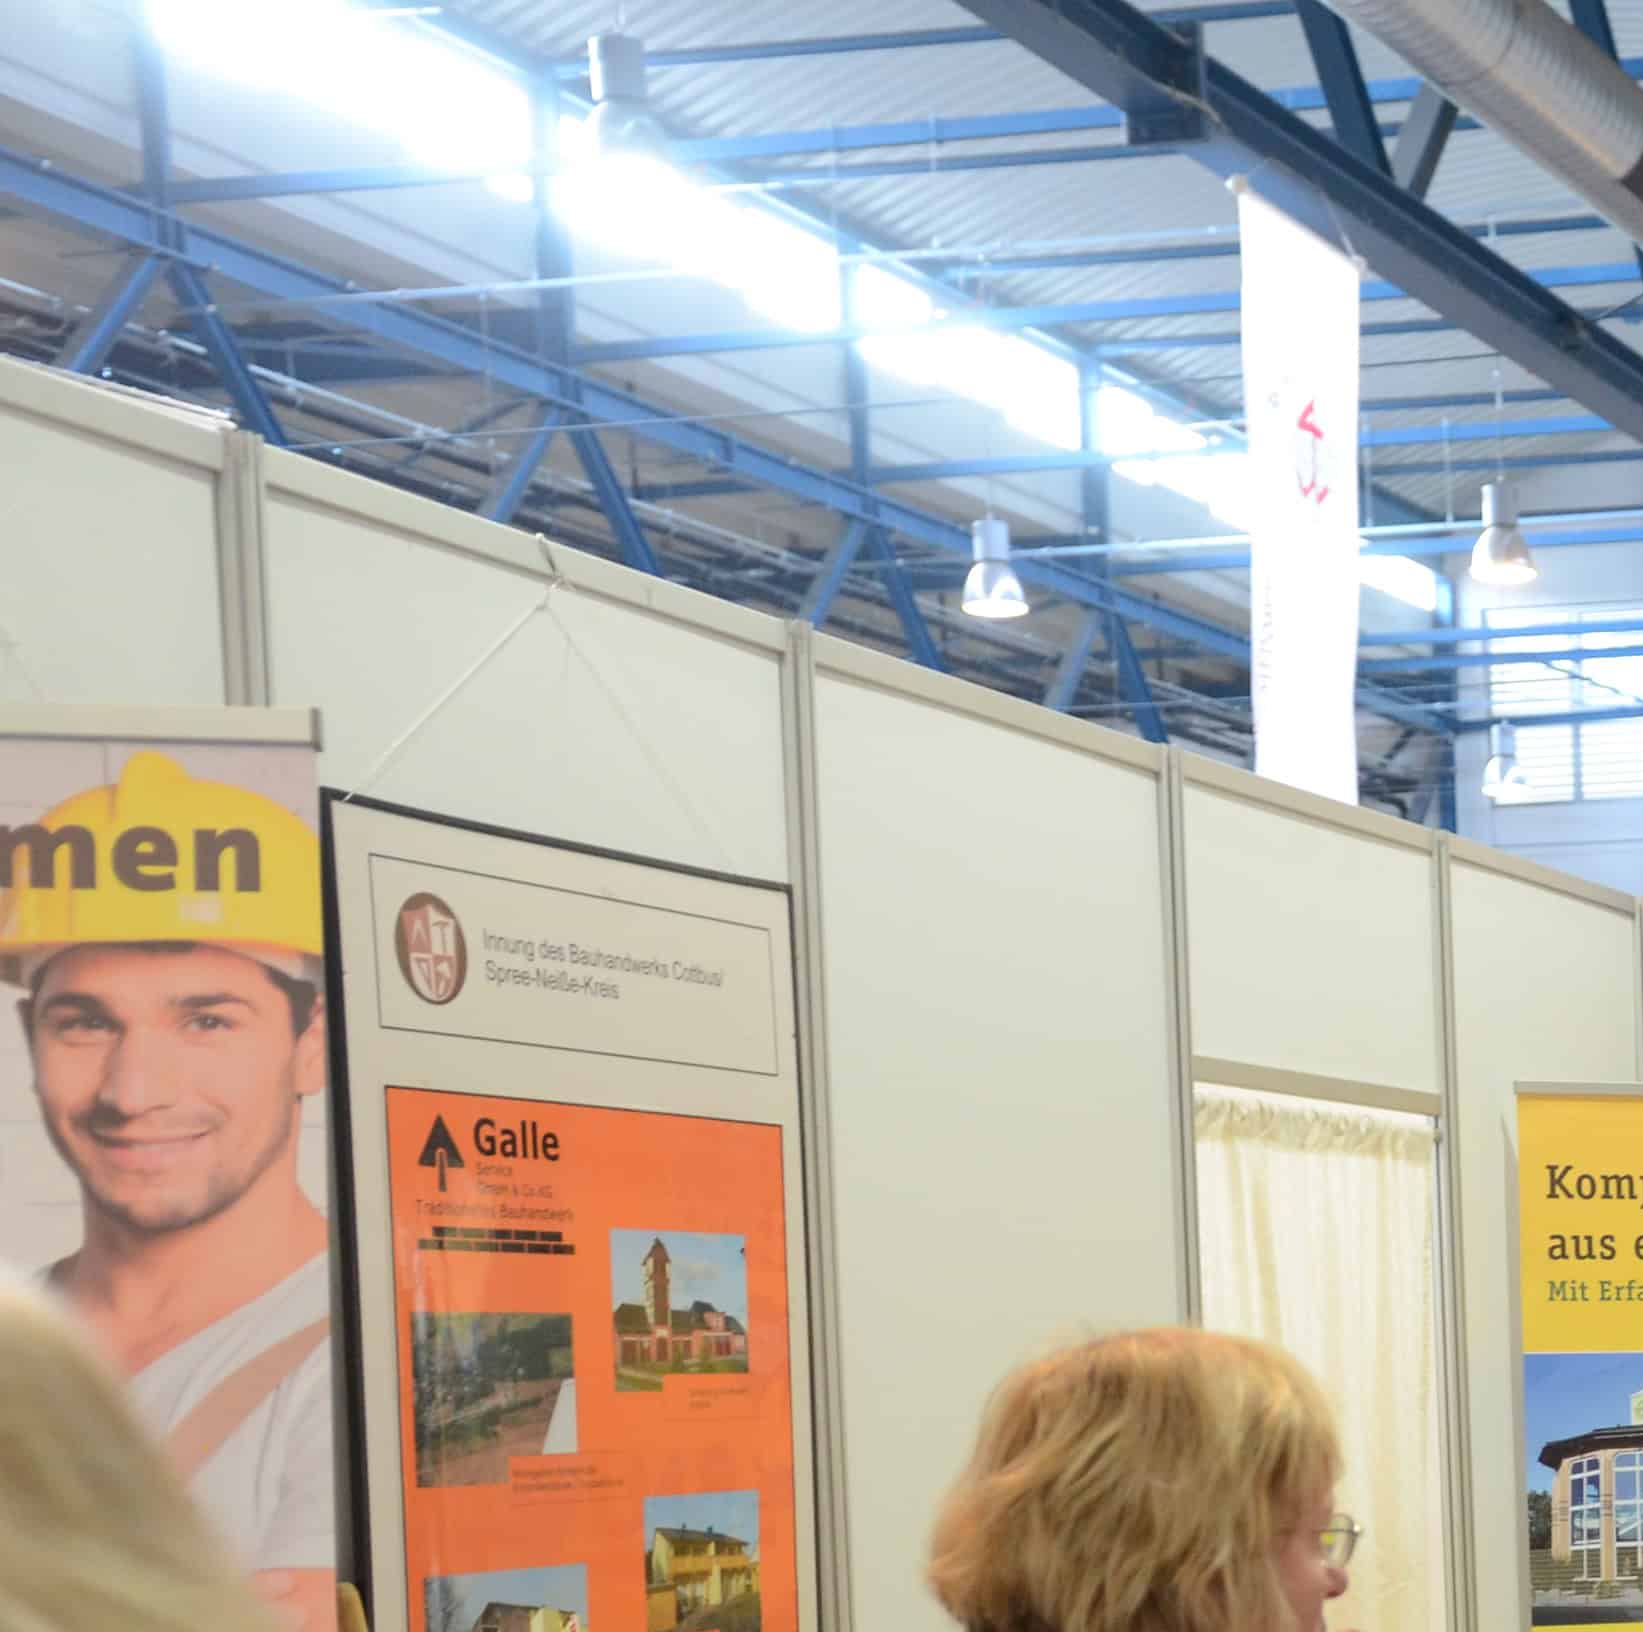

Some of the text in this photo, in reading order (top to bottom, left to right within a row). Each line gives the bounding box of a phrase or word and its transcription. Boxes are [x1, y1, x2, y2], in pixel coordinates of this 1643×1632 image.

[483, 928, 535, 962] Innung
[538, 939, 565, 962] des
[473, 1118, 560, 1161] Galle
[1547, 1232, 1617, 1261] aus
[1548, 1280, 1590, 1302] Mit
